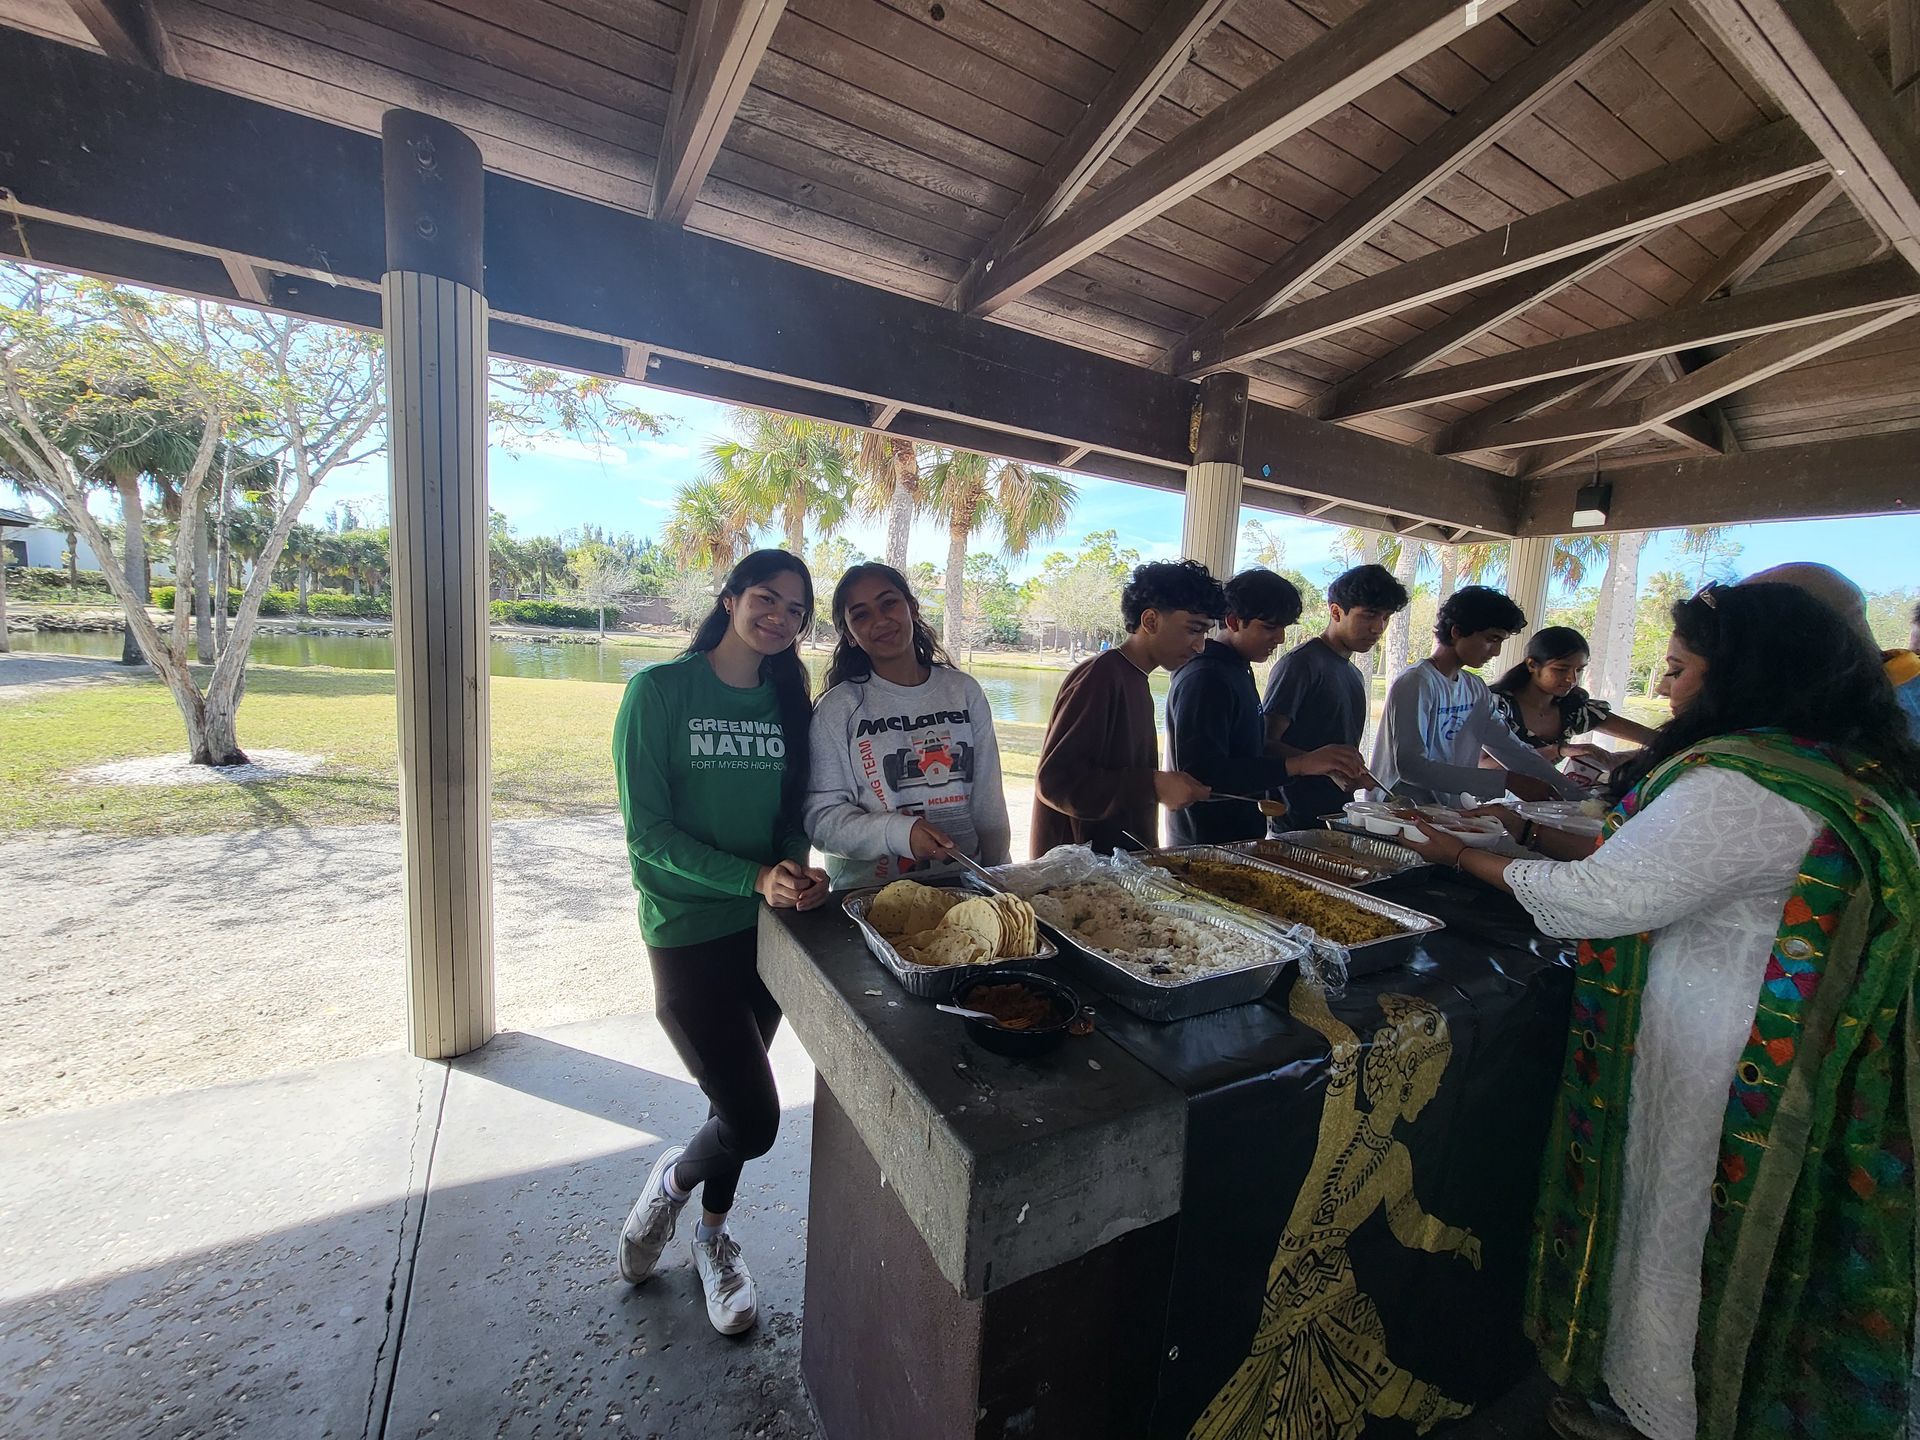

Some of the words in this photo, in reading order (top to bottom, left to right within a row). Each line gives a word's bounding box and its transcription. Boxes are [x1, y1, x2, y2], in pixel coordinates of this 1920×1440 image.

[688, 718, 784, 736] GREENWA
[690, 733, 786, 758] NATIO
[691, 760, 717, 770] FORT
[718, 760, 749, 770] MYERS
[750, 761, 772, 770] HIGH
[858, 739, 878, 779] TEAM
[927, 794, 964, 806] MCLAREN
